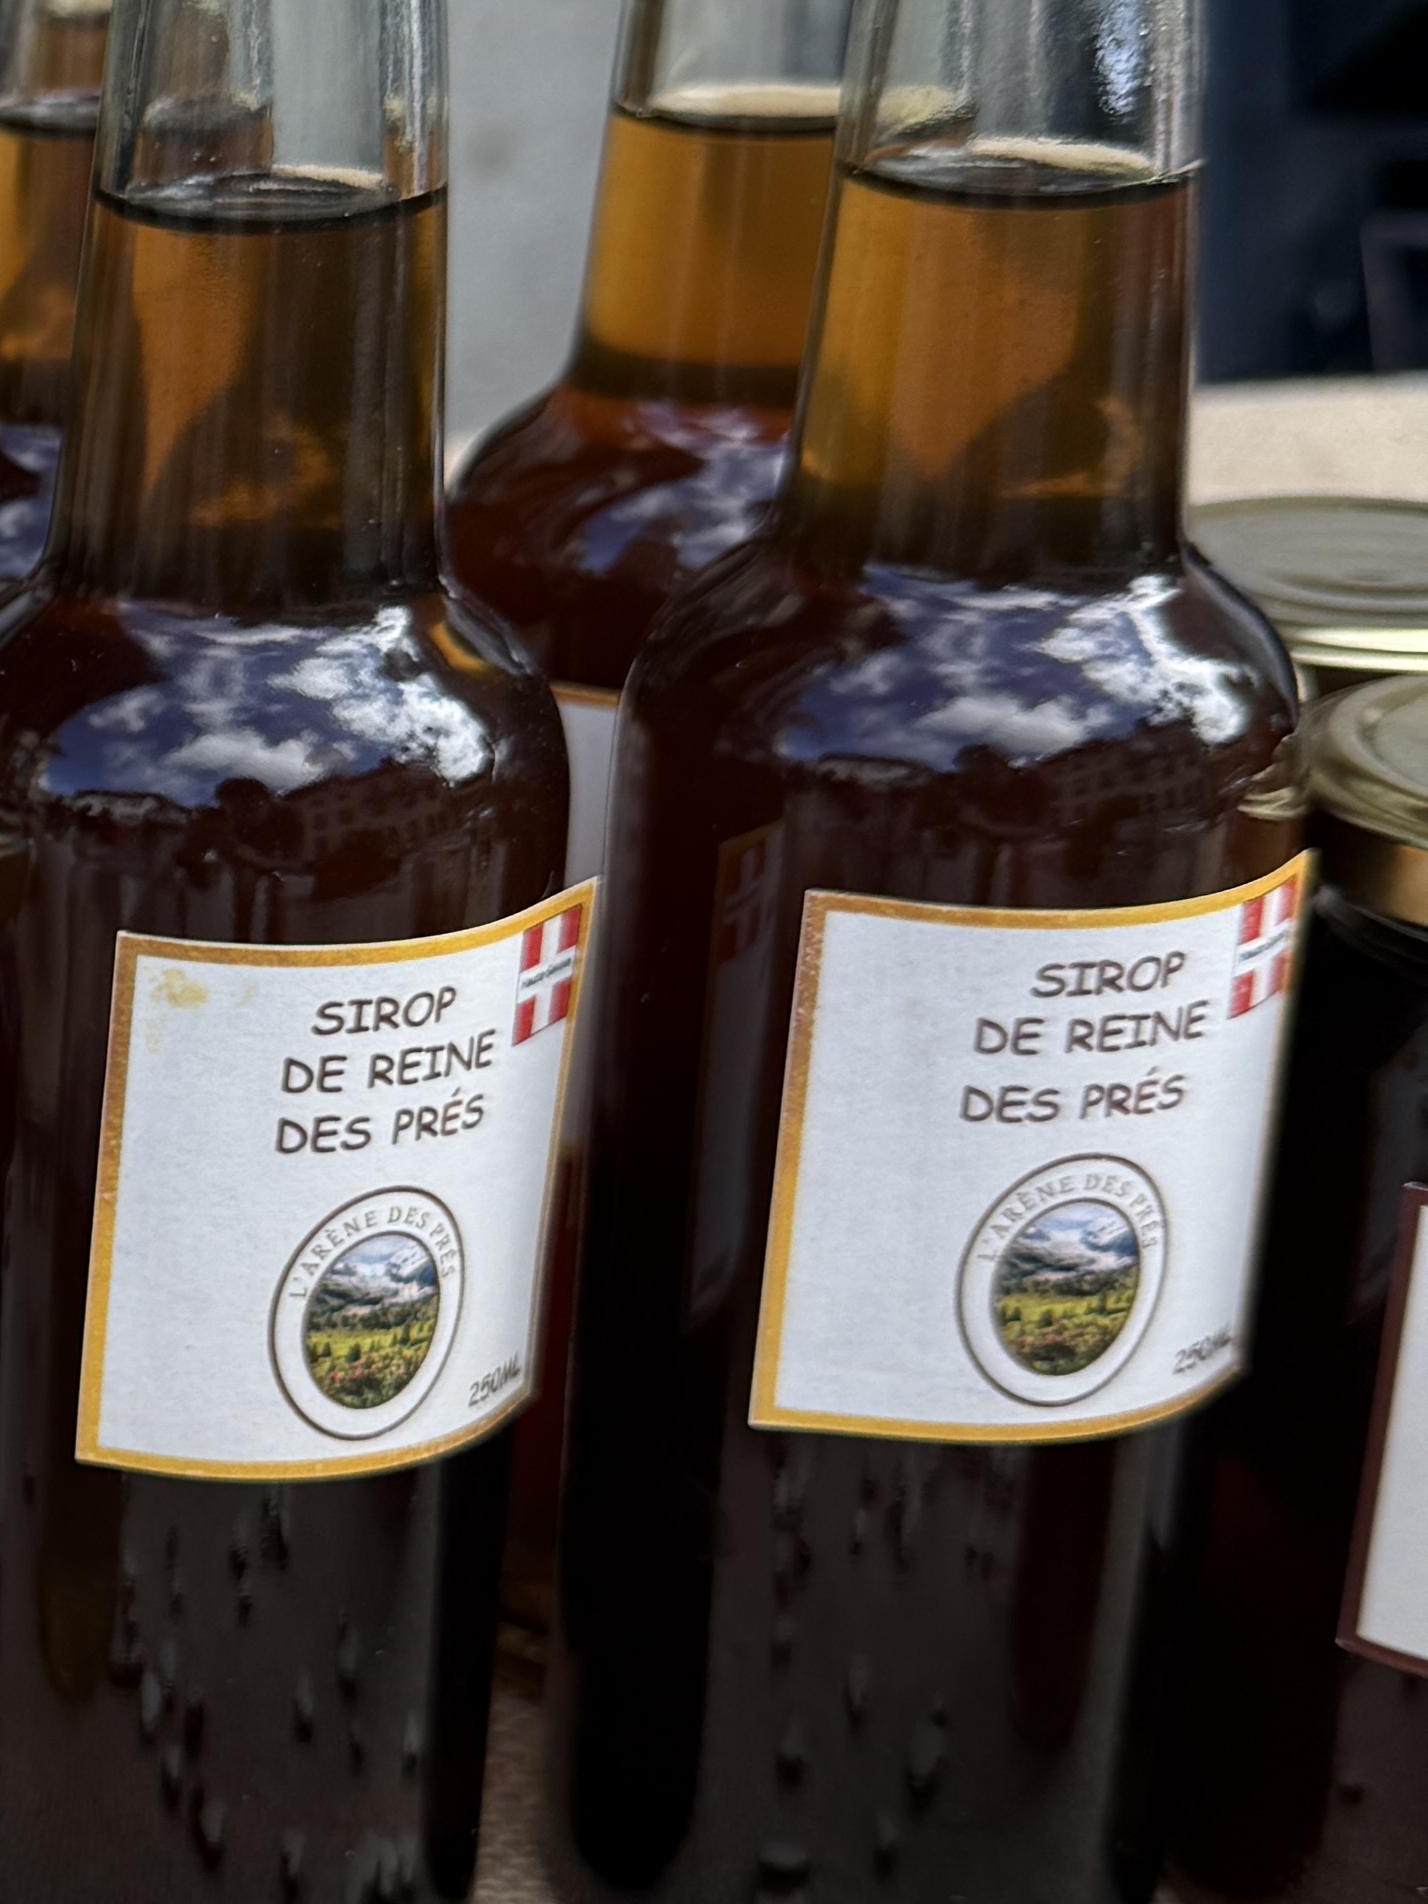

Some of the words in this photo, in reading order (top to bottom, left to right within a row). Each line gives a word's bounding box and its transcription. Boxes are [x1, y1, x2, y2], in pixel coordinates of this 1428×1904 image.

[1031, 950, 1188, 999] SIROP
[311, 986, 457, 1036] SIROP
[972, 1017, 1044, 1057] DE
[1064, 998, 1211, 1055] REINE
[281, 1056, 346, 1095] DE
[367, 1028, 497, 1090] REINE
[274, 1116, 371, 1155] DES
[390, 1086, 485, 1146] PRÉS
[958, 1084, 1060, 1124] DES
[1078, 1065, 1188, 1121] PRÉS
[1083, 1173, 1136, 1199] DES
[387, 1206, 431, 1230] DES
